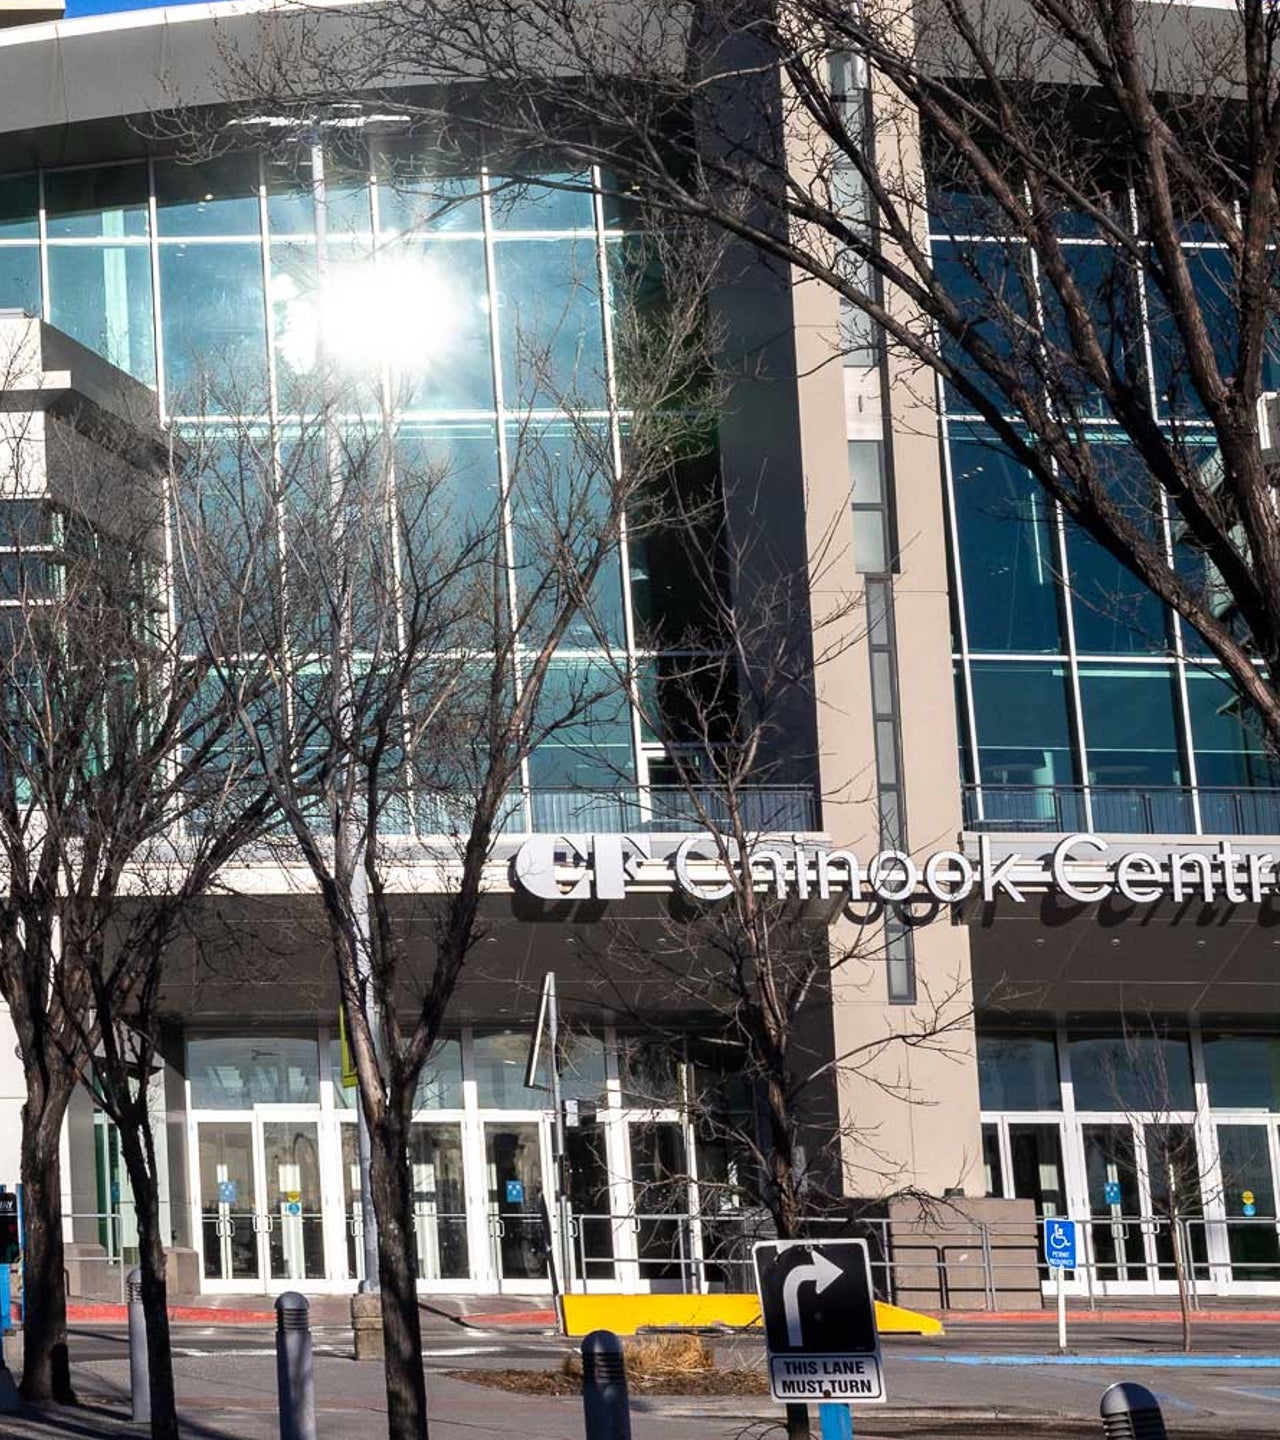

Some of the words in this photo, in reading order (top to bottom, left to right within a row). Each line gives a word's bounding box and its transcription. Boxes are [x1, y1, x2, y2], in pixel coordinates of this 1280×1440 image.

[1053, 833, 1280, 903] Centr
[783, 1361, 818, 1375] THIS
[823, 1361, 865, 1375] LANE
[782, 1380, 824, 1393] MUST
[828, 1380, 872, 1393] TURN
